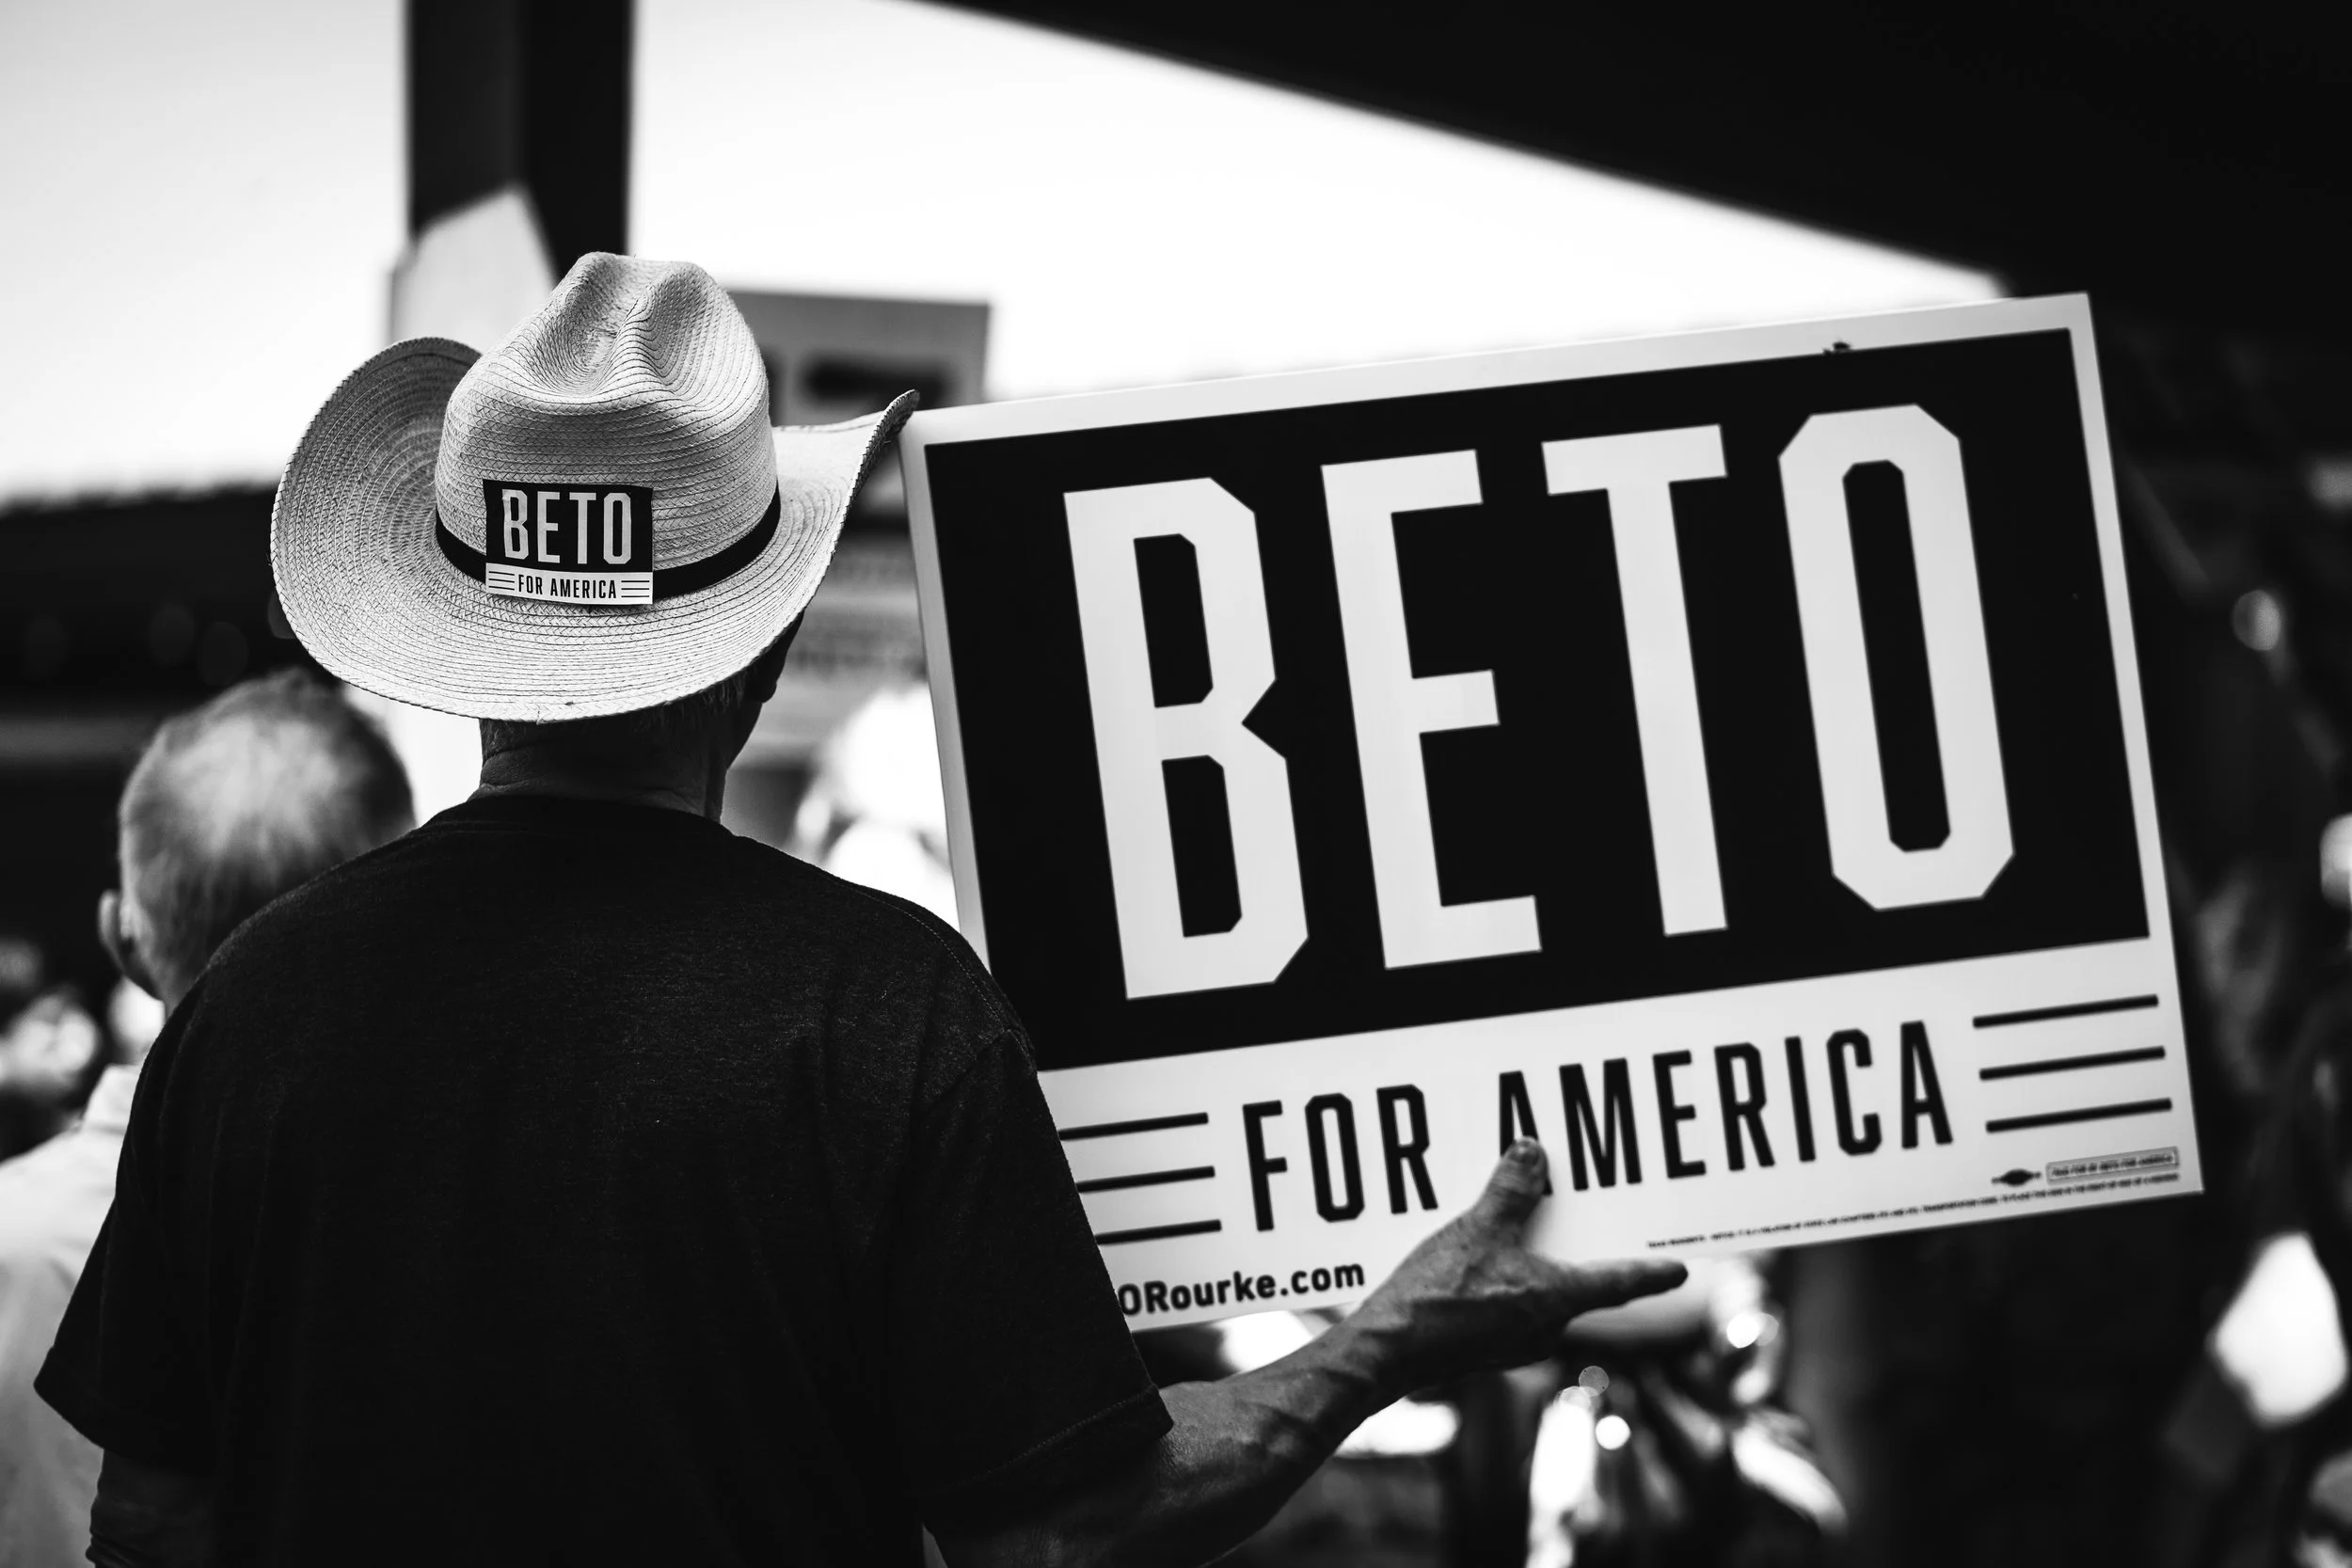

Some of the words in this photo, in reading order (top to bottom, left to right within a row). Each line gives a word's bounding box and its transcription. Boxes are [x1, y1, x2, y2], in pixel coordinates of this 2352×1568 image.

[501, 488, 632, 564] BETO
[517, 574, 543, 595] FOR
[549, 578, 617, 599] AMERICA
[1063, 404, 2013, 999] BETO
[1242, 1084, 1438, 1232] FOR
[1499, 1021, 1954, 1196] AMERICA
[1117, 1263, 1365, 1316] ORourke.com
